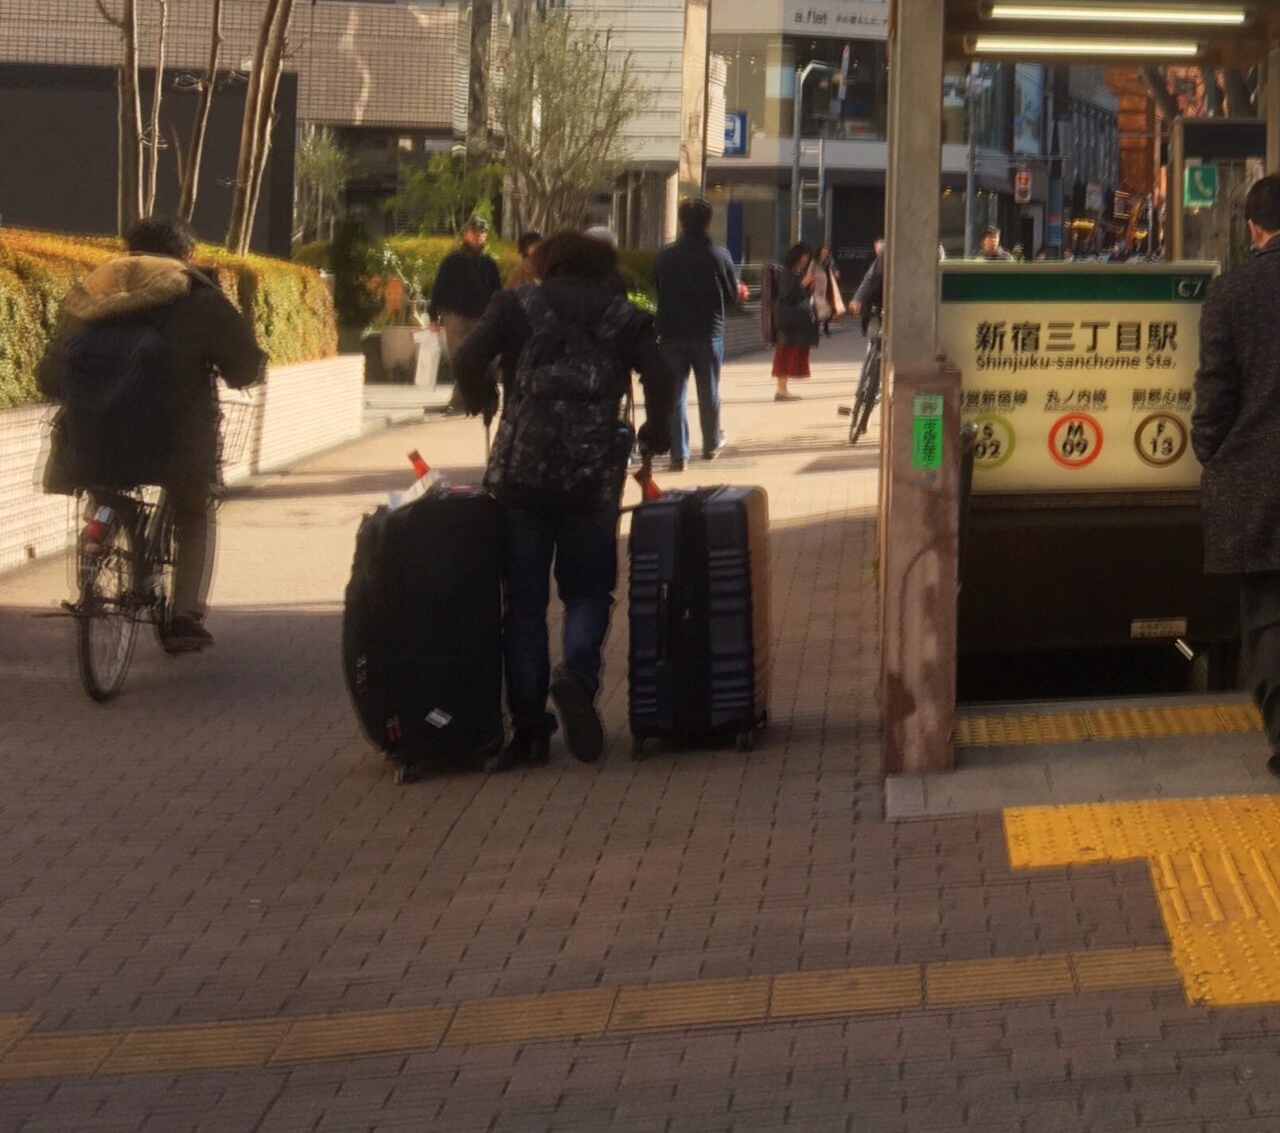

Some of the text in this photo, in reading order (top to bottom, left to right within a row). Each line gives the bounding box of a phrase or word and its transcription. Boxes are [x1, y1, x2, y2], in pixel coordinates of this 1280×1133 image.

[1177, 280, 1202, 298] C7
[974, 321, 1178, 353] 新宿三丁目駅
[976, 353, 1176, 373] Shinjuku-sanchome Sta.
[1046, 389, 1108, 404] 丸ノ内線
[982, 423, 993, 440] S
[1066, 422, 1084, 439] M
[1156, 423, 1166, 438] F
[974, 440, 1001, 459] 02
[1062, 439, 1089, 457] 09
[1149, 437, 1174, 455] 13
